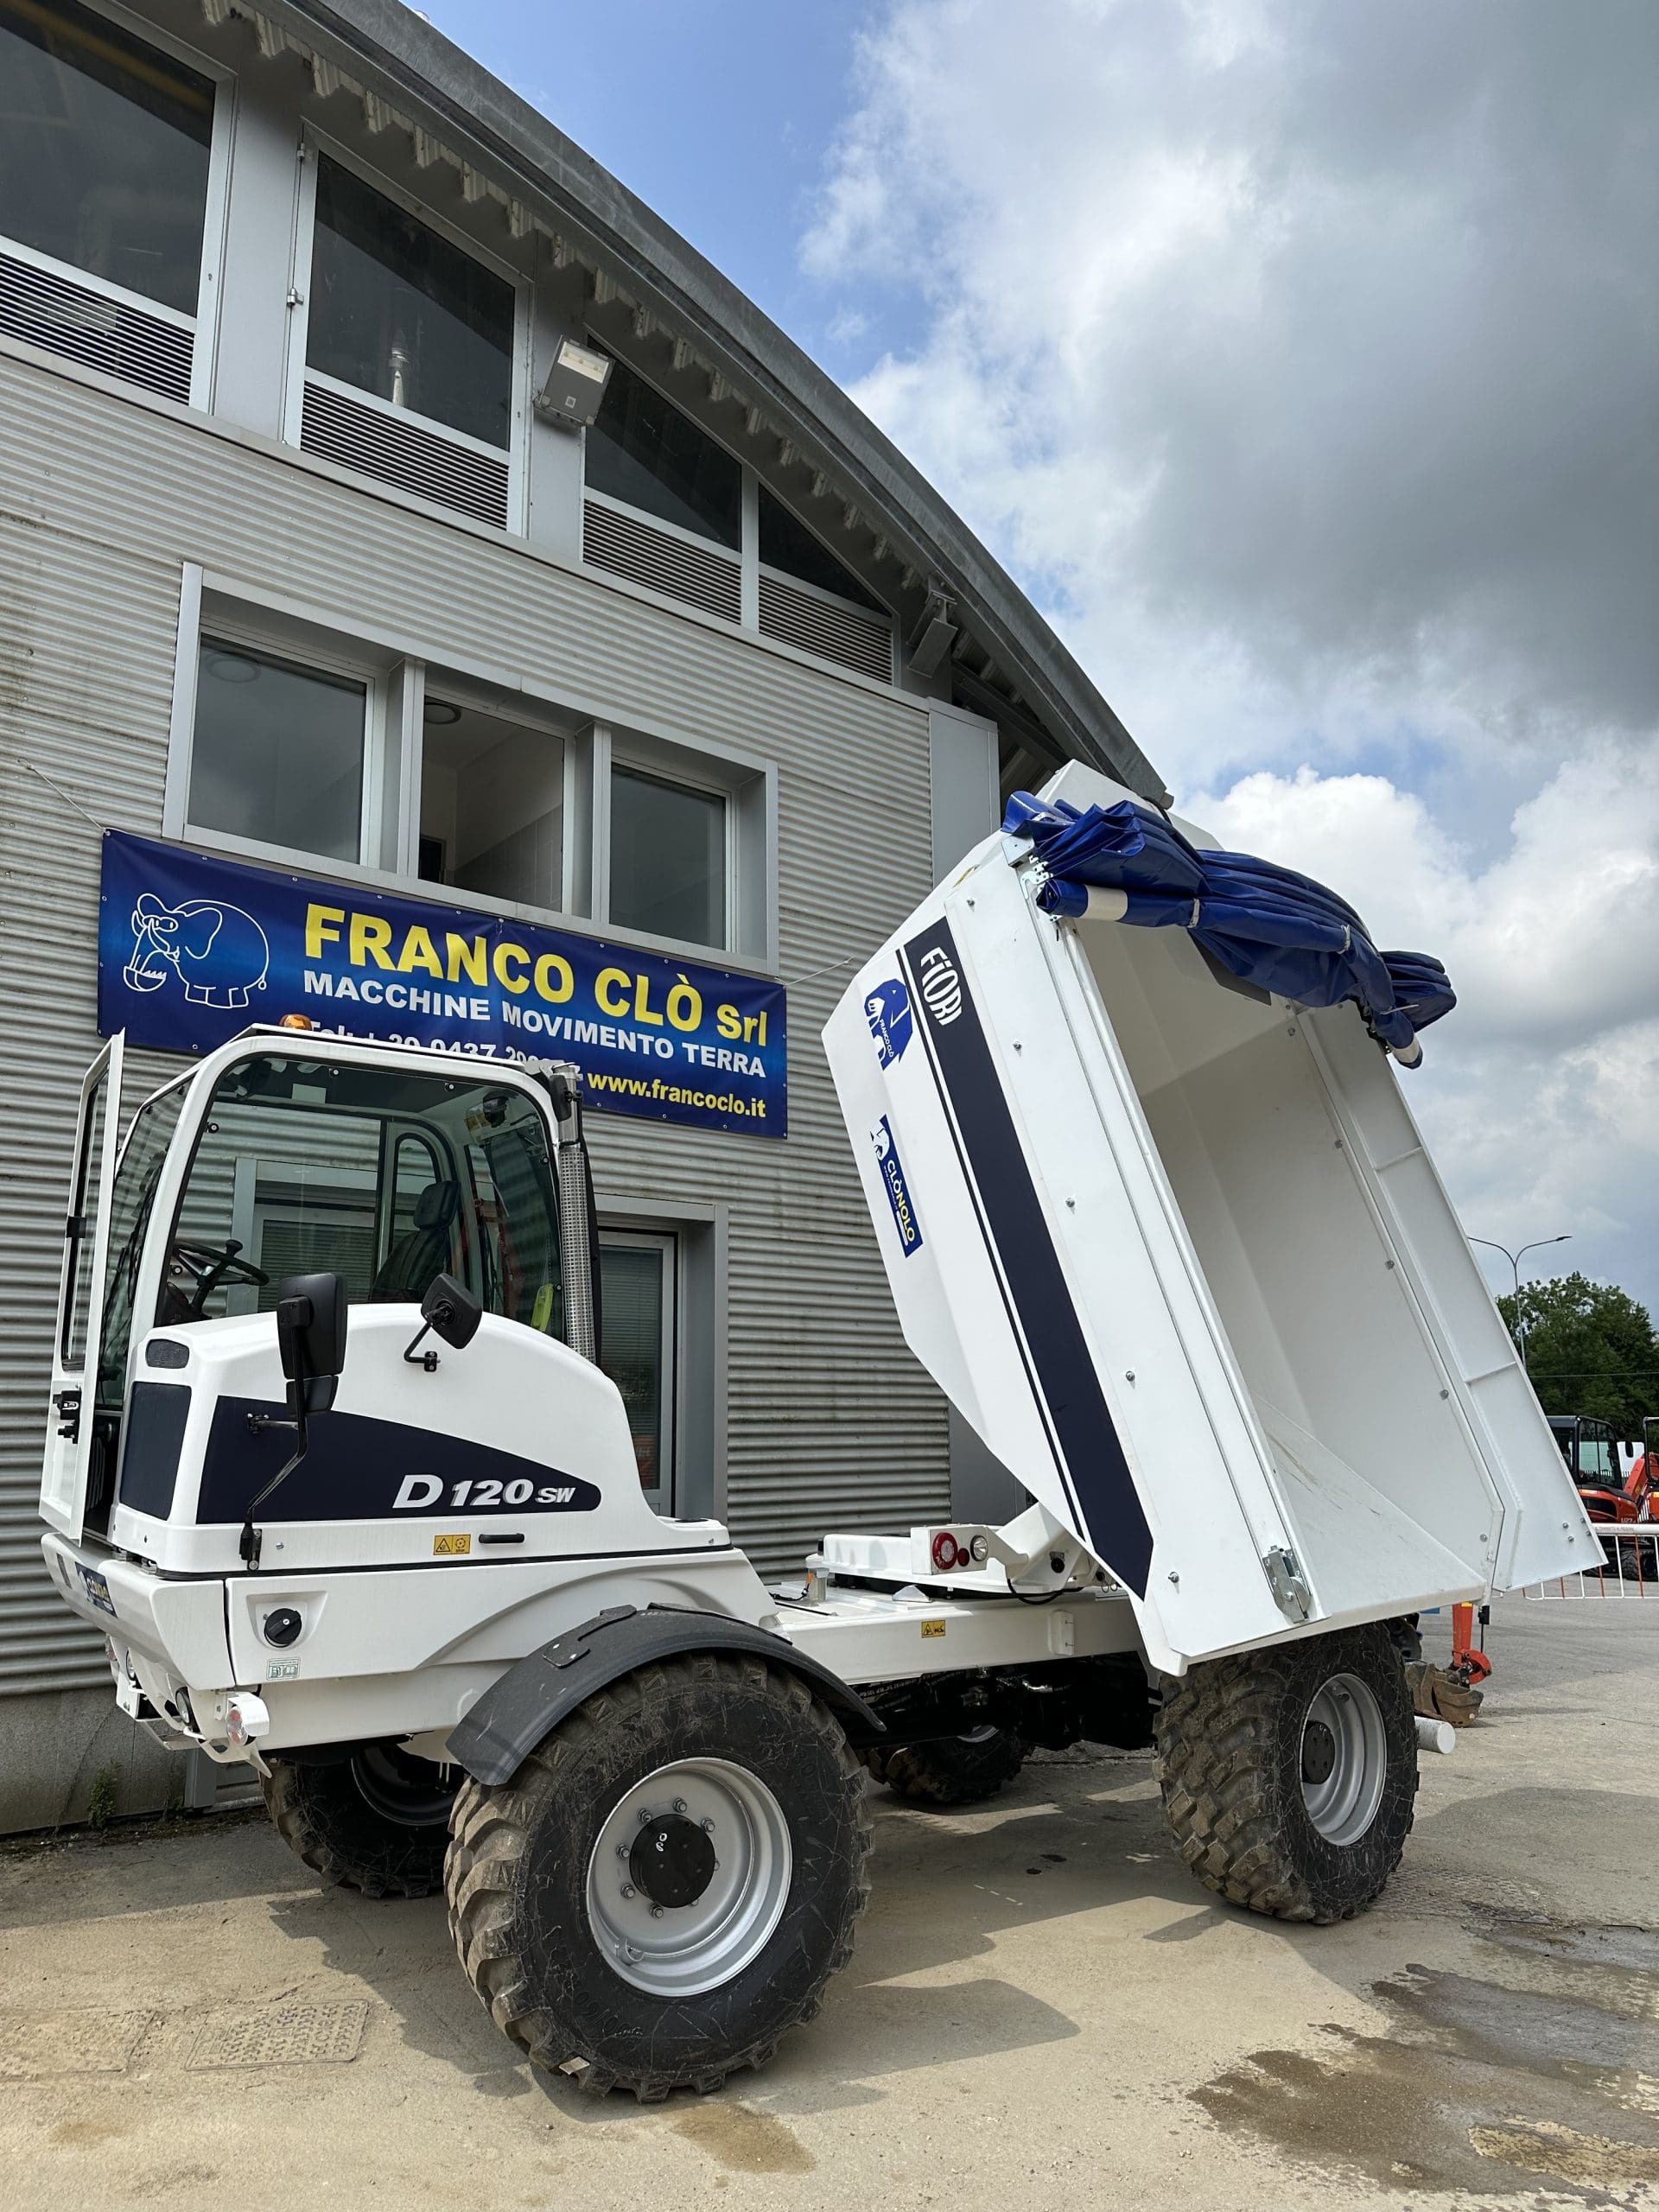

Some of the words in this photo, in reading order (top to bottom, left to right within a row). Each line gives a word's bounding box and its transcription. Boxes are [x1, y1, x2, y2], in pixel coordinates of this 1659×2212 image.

[305, 904, 574, 1003] FRANCO
[594, 967, 702, 1032] CLÒ
[717, 1004, 767, 1046] Srl
[303, 969, 491, 1020] MACCHINE
[501, 1001, 674, 1059] MOVIMENTO
[667, 1030, 766, 1078] TERRA
[588, 1072, 766, 1117] www.francoclo.it
[887, 1160, 915, 1242] CLÒNOLO
